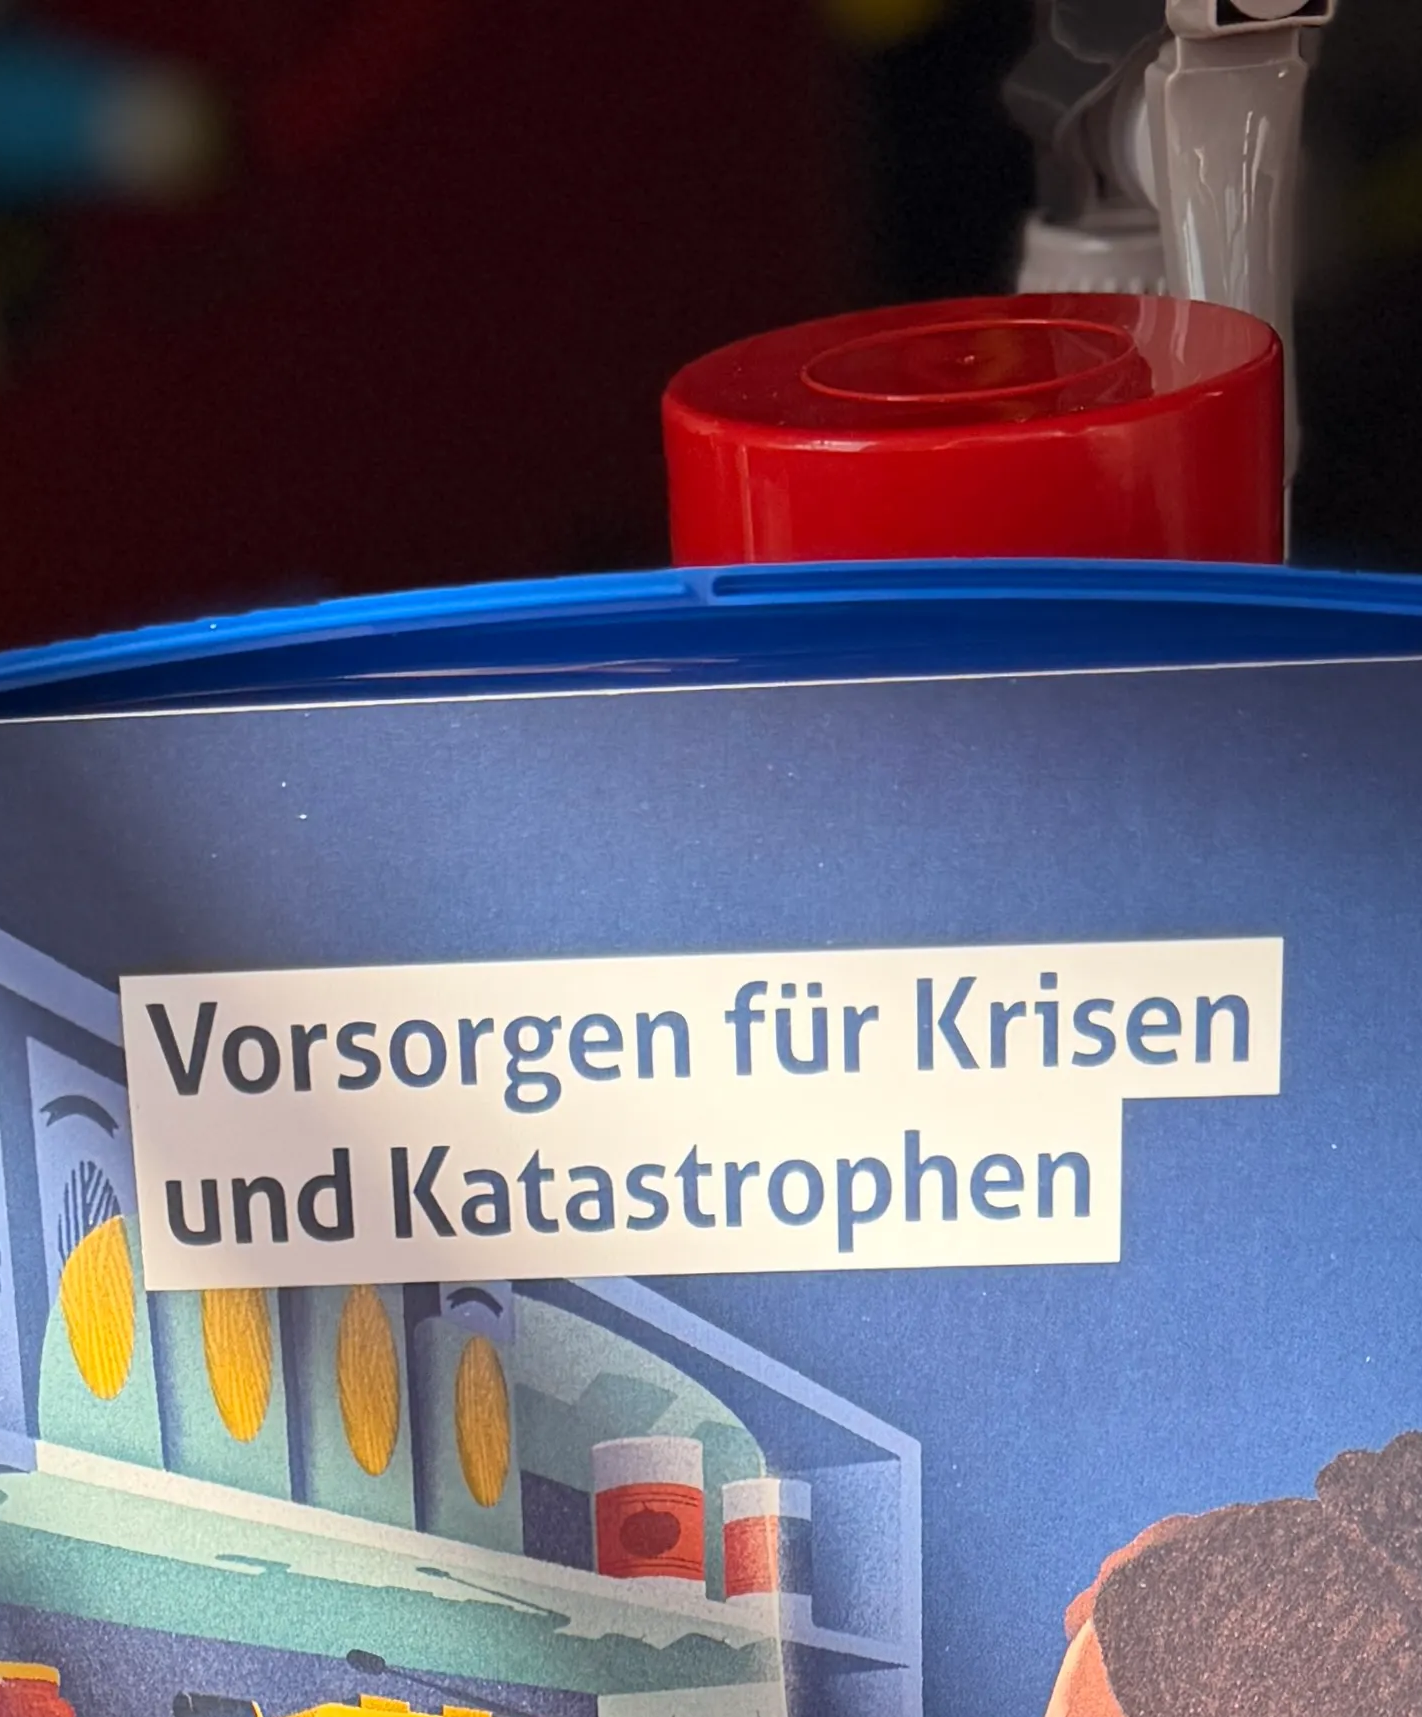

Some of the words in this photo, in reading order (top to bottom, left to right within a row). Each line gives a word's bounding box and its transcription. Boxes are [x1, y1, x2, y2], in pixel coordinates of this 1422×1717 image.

[146, 1000, 692, 1116] Vorsorgen
[725, 982, 880, 1079] für
[916, 971, 1251, 1072] Krisen
[165, 1147, 351, 1247] und
[391, 1130, 1092, 1254] Katastrophen
